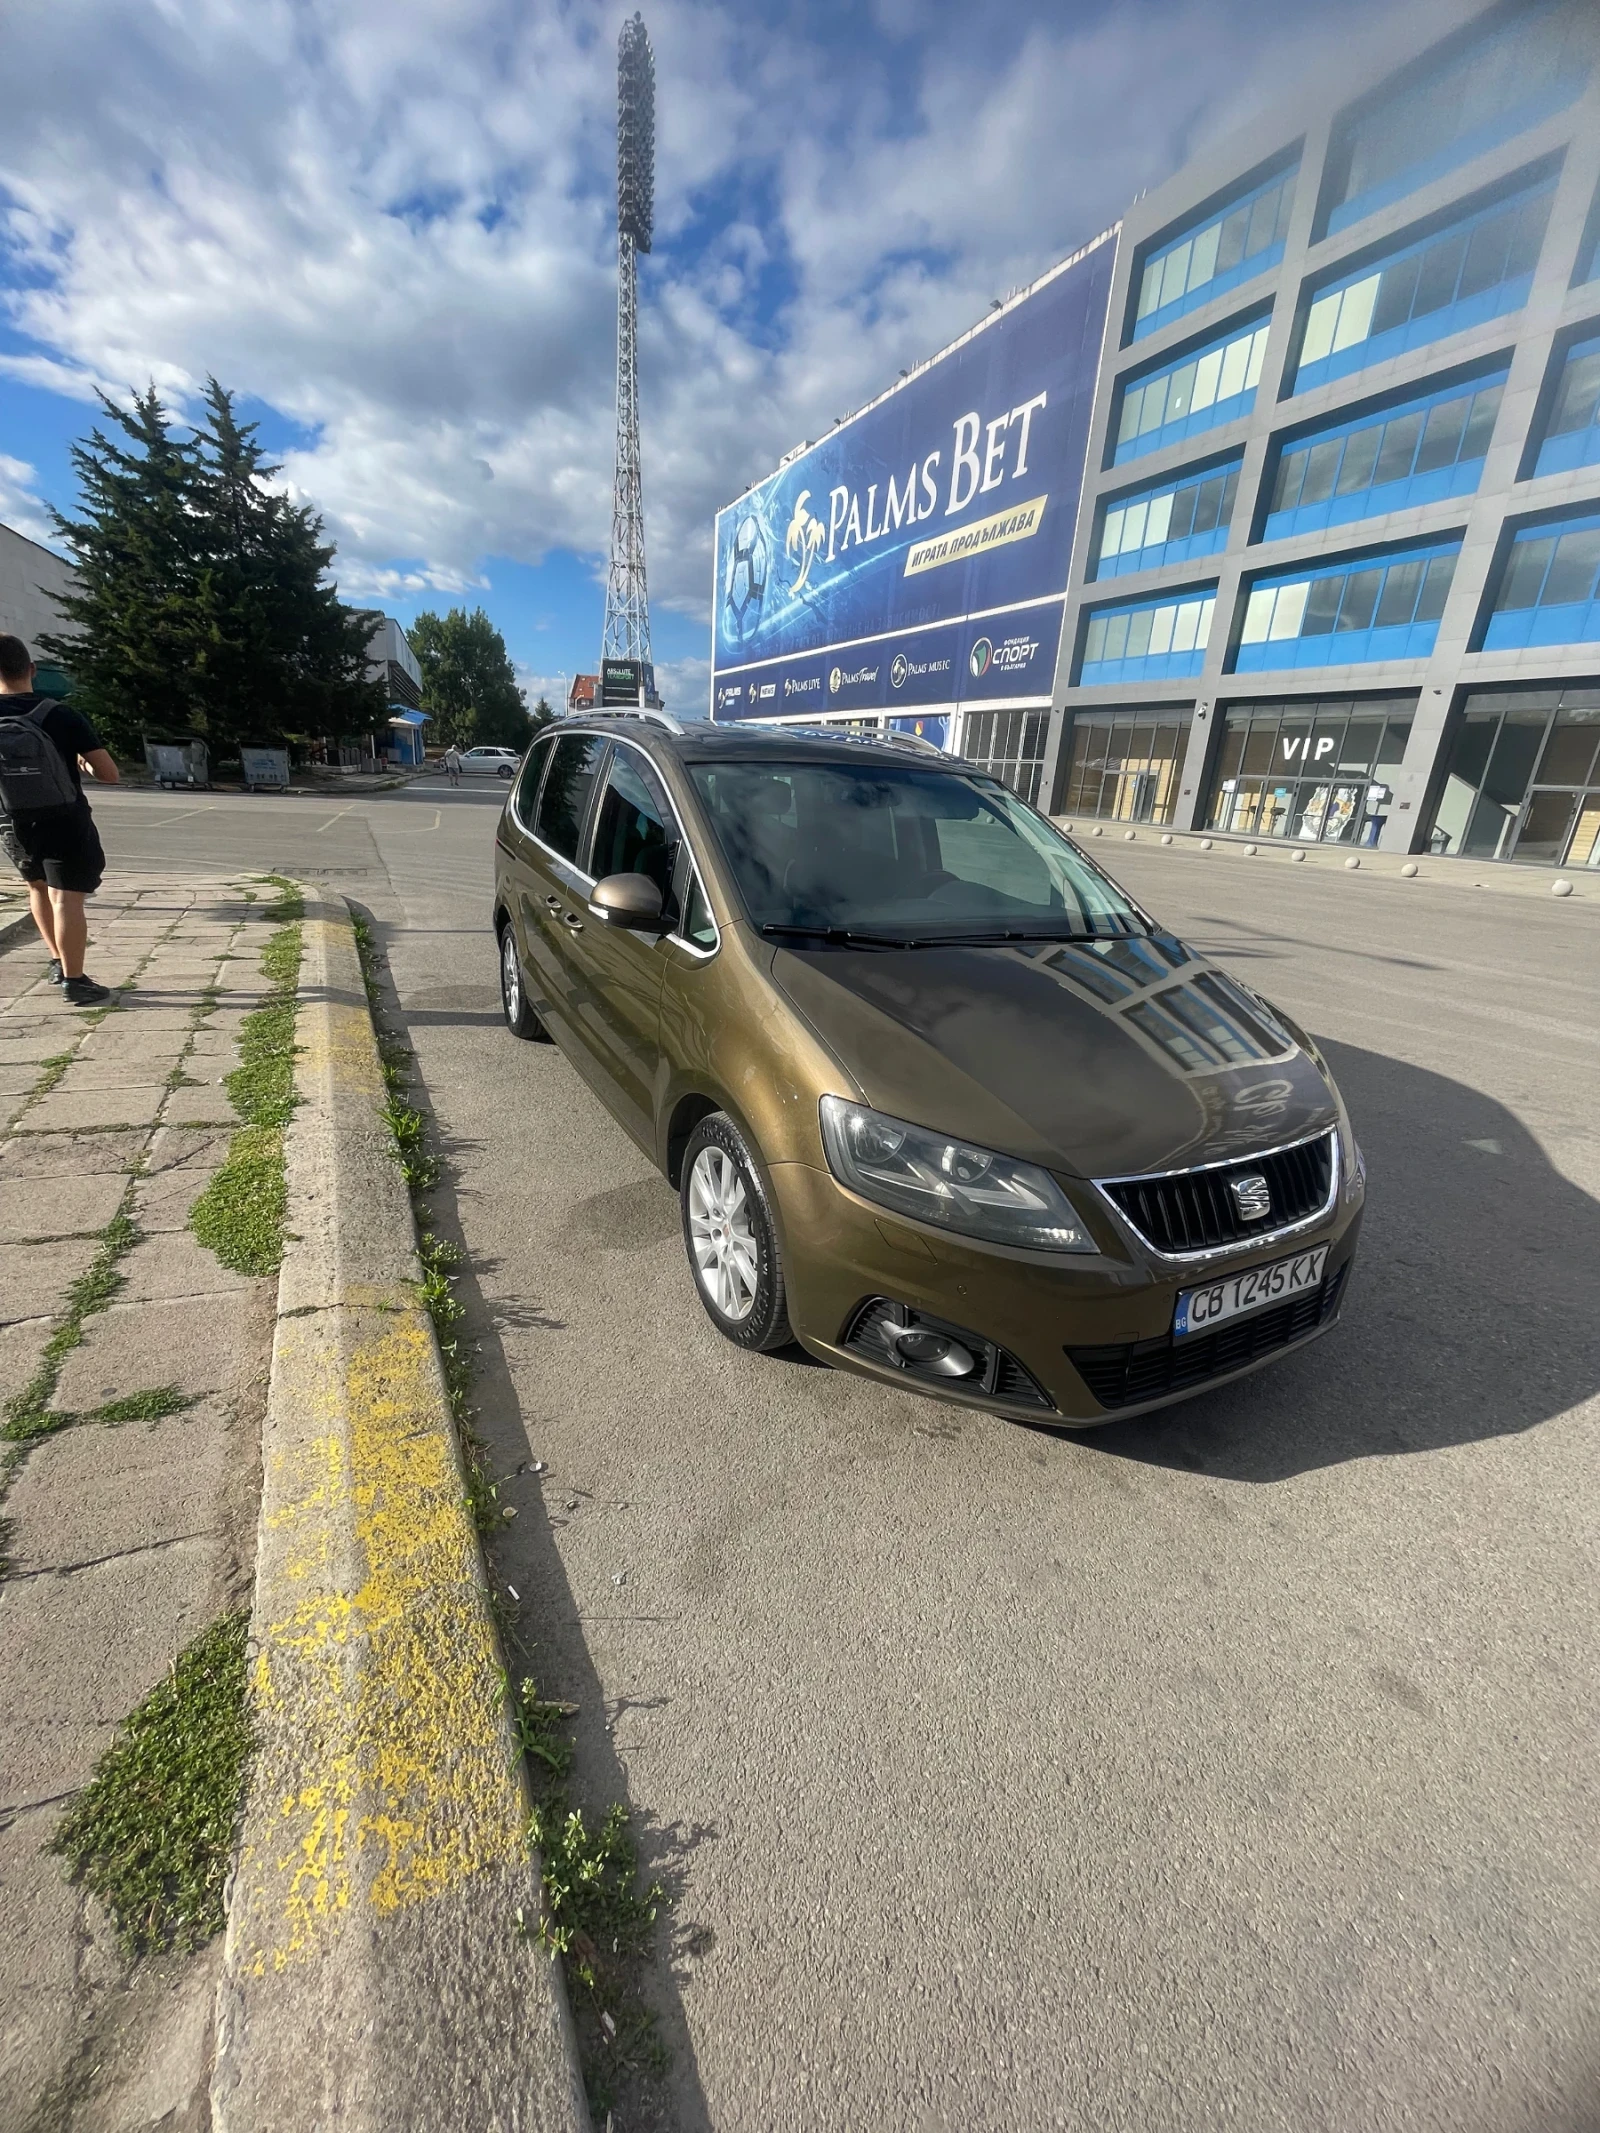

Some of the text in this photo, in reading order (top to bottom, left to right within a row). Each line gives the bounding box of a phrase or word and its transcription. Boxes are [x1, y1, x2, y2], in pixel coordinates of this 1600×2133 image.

[826, 390, 1047, 563] PALMS BET
[911, 509, 1036, 567] ИГРАТА ПРОДЪЛЖАВА
[1004, 635, 1030, 646] ФОНДАЦИЯ
[992, 642, 1040, 664] СПОРТ
[908, 659, 951, 677] PALMS MUSIC
[791, 678, 821, 694] PALMS LIVE
[841, 672, 859, 686] PALMS
[761, 686, 775, 696] NEWS
[1283, 737, 1335, 760] VIP
[1192, 1251, 1324, 1323] CB 1245 KX
[1175, 1316, 1187, 1330] BG
